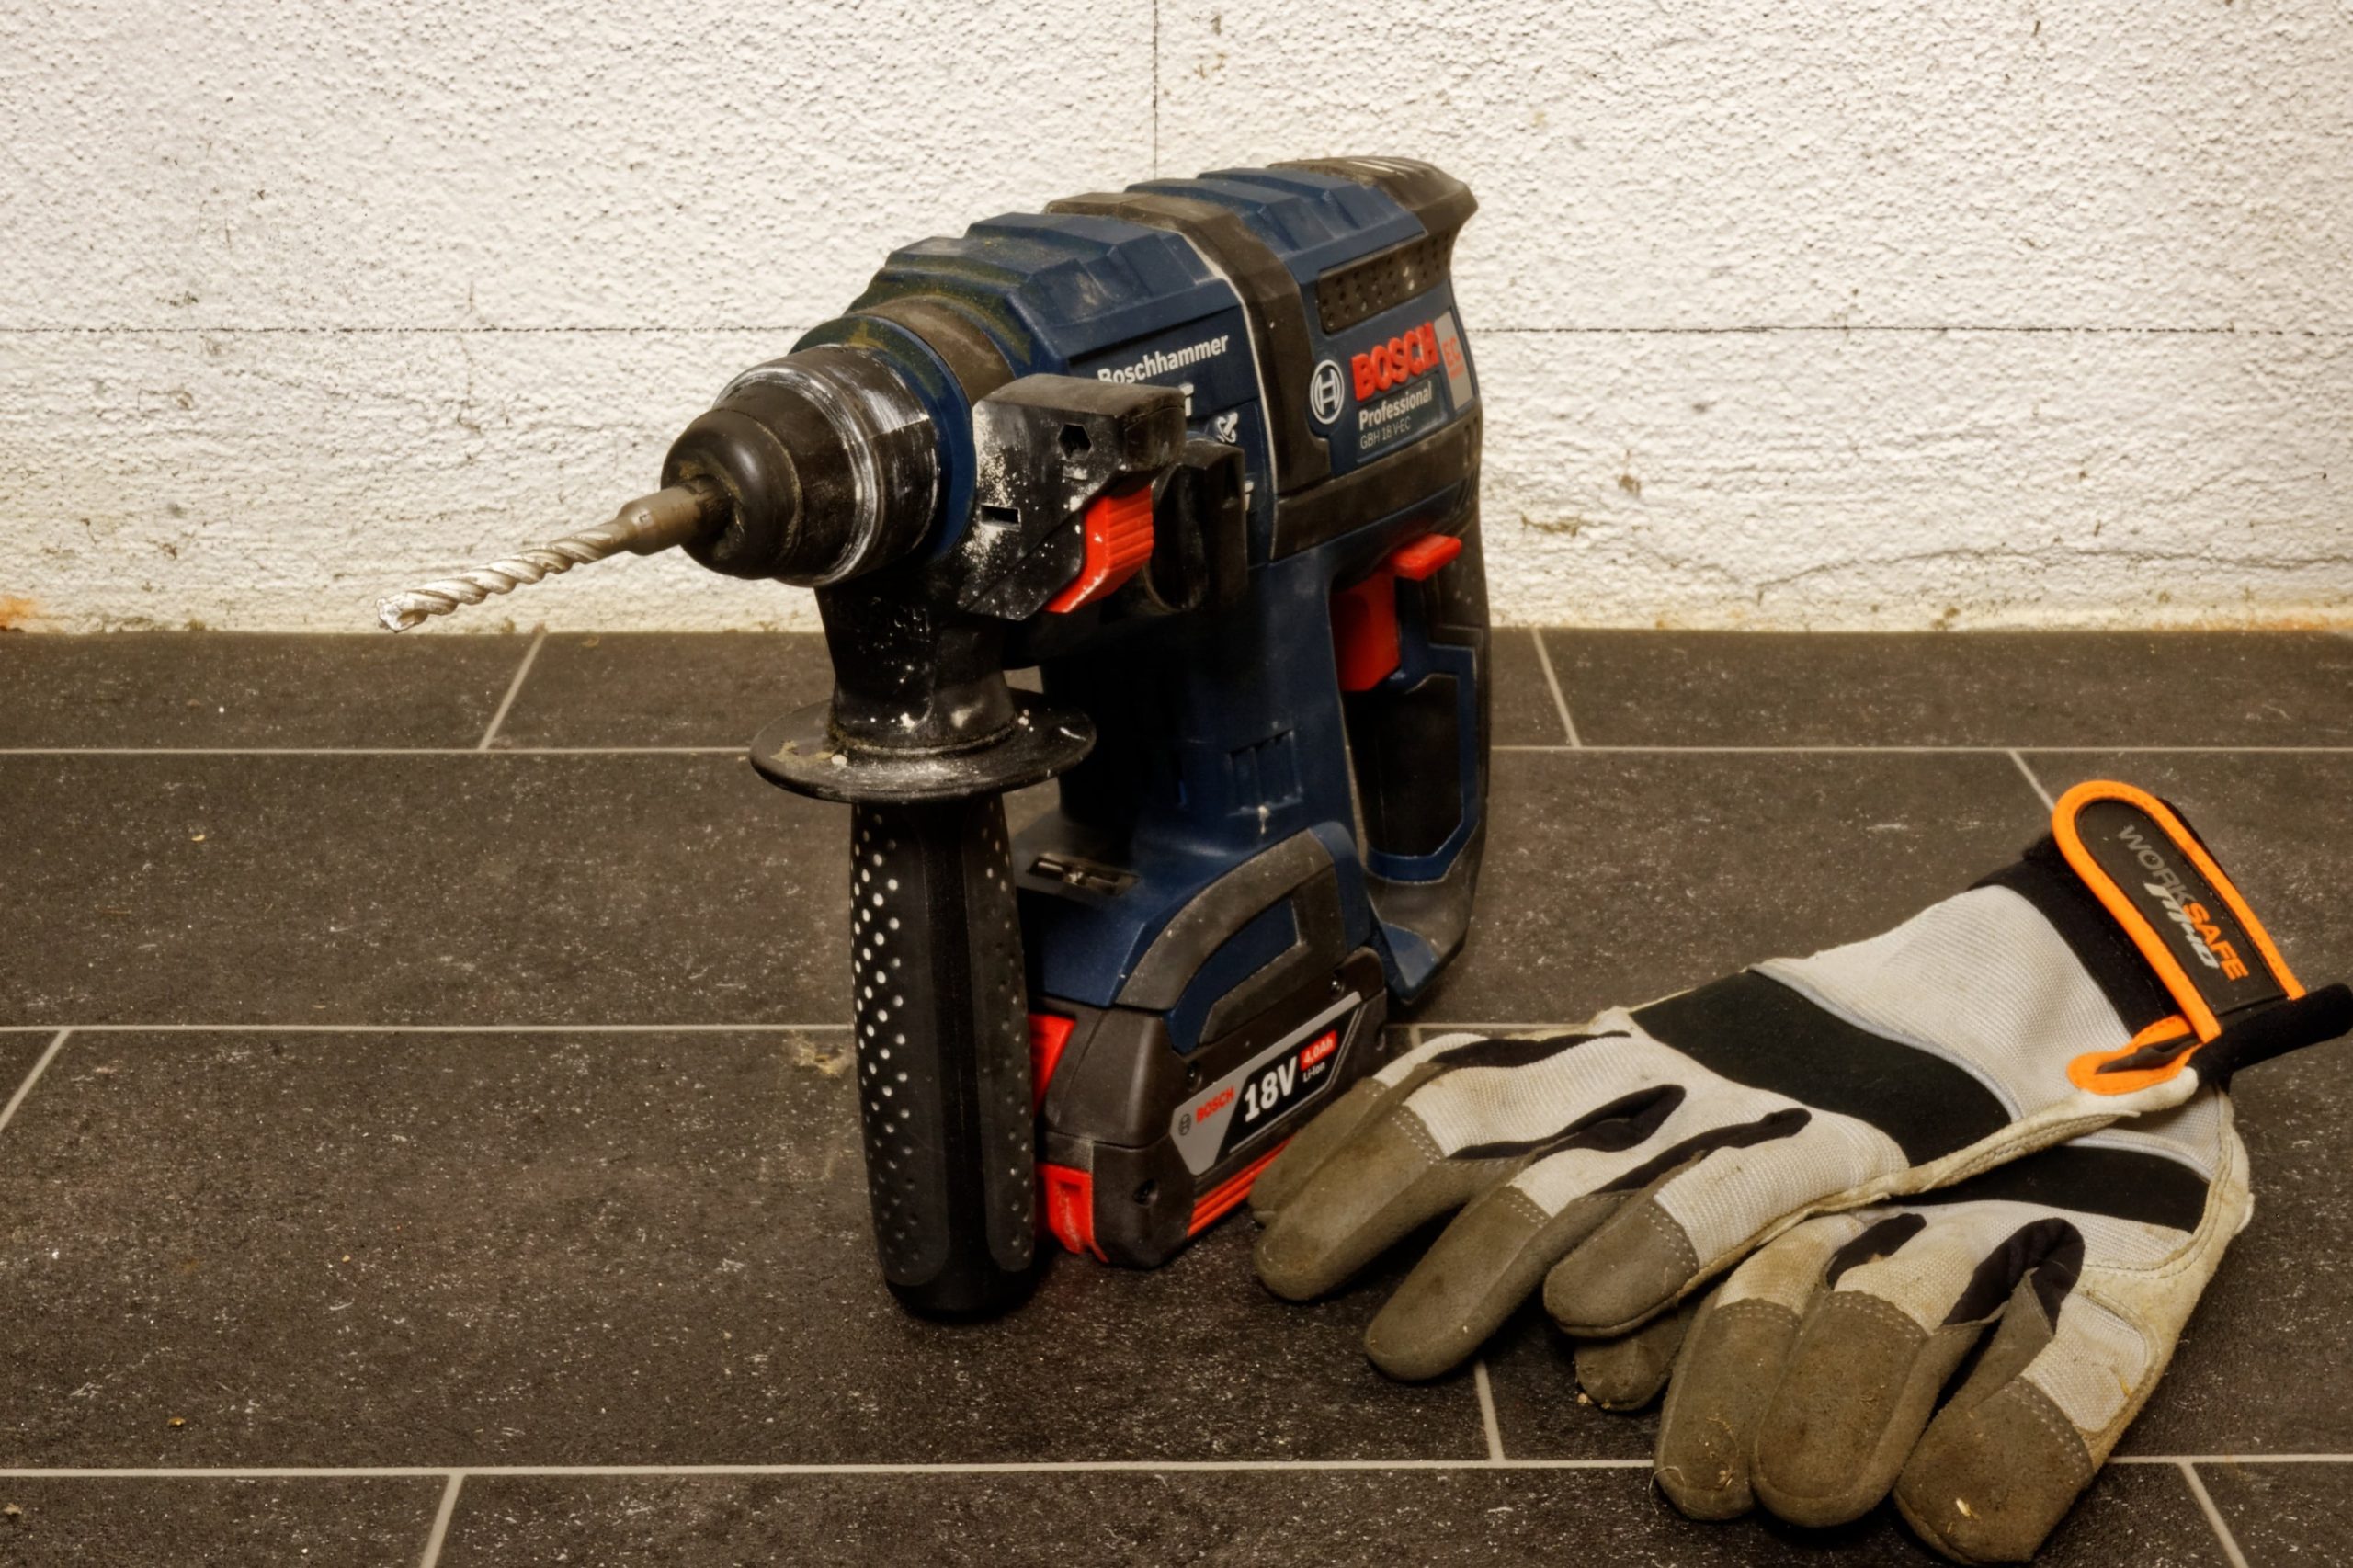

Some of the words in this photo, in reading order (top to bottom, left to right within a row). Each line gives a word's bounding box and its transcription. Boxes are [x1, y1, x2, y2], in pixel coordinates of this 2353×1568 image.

[1097, 335, 1229, 384] Boschhammer
[1351, 321, 1440, 402] BOSCH
[1359, 381, 1433, 430] Professional
[1360, 432, 1380, 449] GBH
[2118, 825, 2249, 982] WORKSAFE
[1196, 1085, 1235, 1124] BOSCH
[1245, 1056, 1298, 1122] 18V
